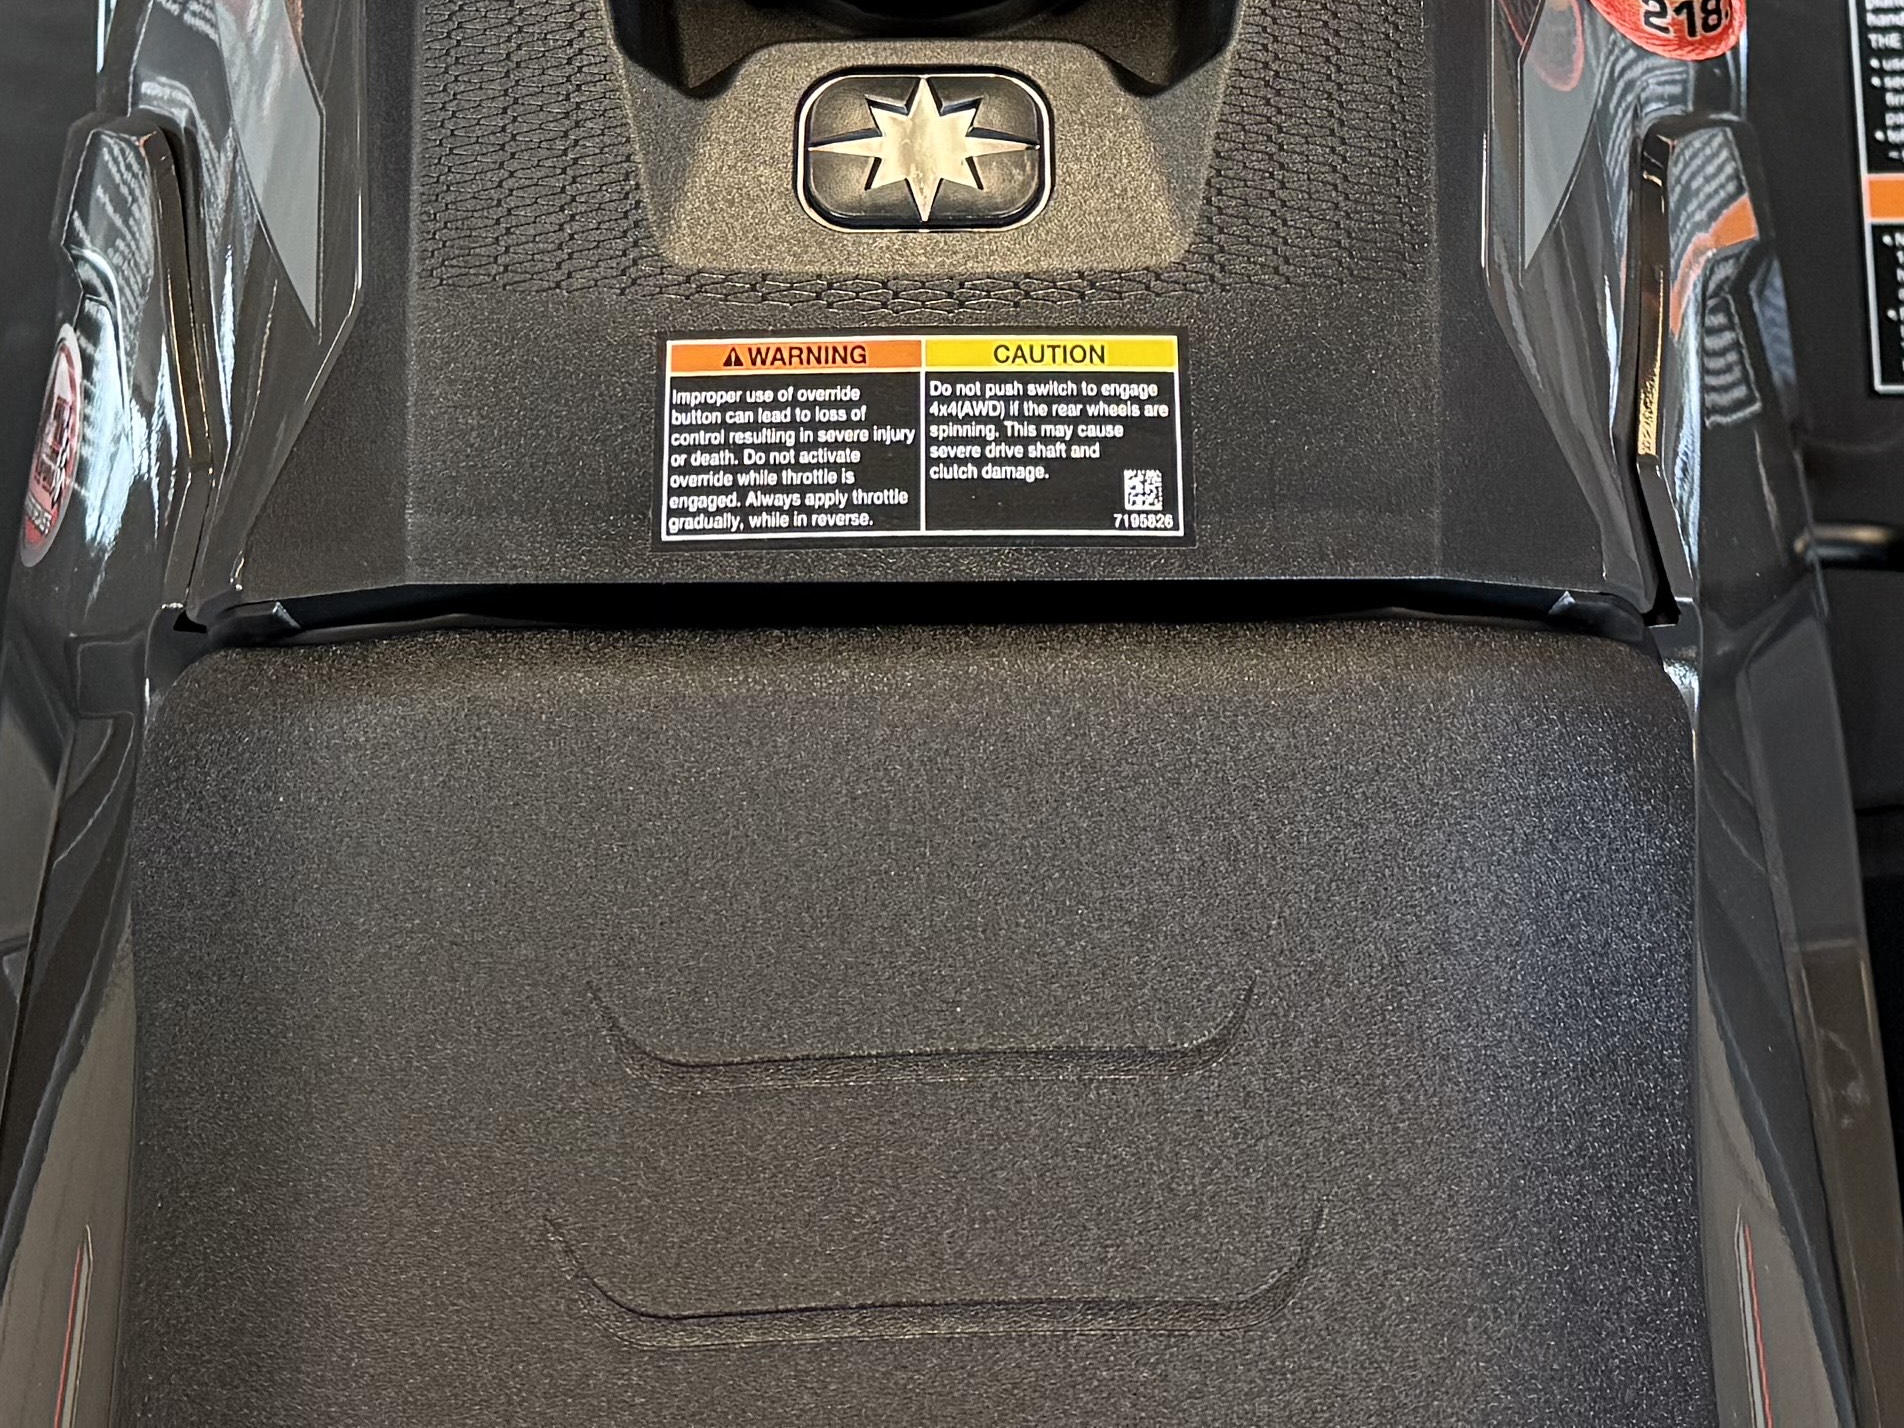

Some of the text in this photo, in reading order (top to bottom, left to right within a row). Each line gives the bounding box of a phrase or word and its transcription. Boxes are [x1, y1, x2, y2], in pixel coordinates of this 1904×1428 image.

[1867, 32, 1900, 48] THE
[747, 344, 866, 366] WARNING
[993, 344, 1104, 364] CAUTION
[672, 385, 860, 406] Improper use of override
[929, 379, 1157, 398] Do not push switch to engage
[671, 405, 866, 425] button can lead to loss of
[929, 400, 1168, 419] 4x4(AWD) if the rear wheels are
[670, 425, 915, 446] control resulting in severe injury
[929, 420, 1123, 440] spinning. This may cause
[670, 447, 860, 467] or death. Do not activate
[929, 441, 1099, 458] severe drive shaft and
[669, 468, 854, 487] override while throttle is
[929, 462, 1049, 481] clutch damage.
[669, 488, 908, 509] engaged. Always apply throttle
[668, 510, 873, 532] gradually, while in reverse.
[1113, 513, 1173, 528] 7195826
